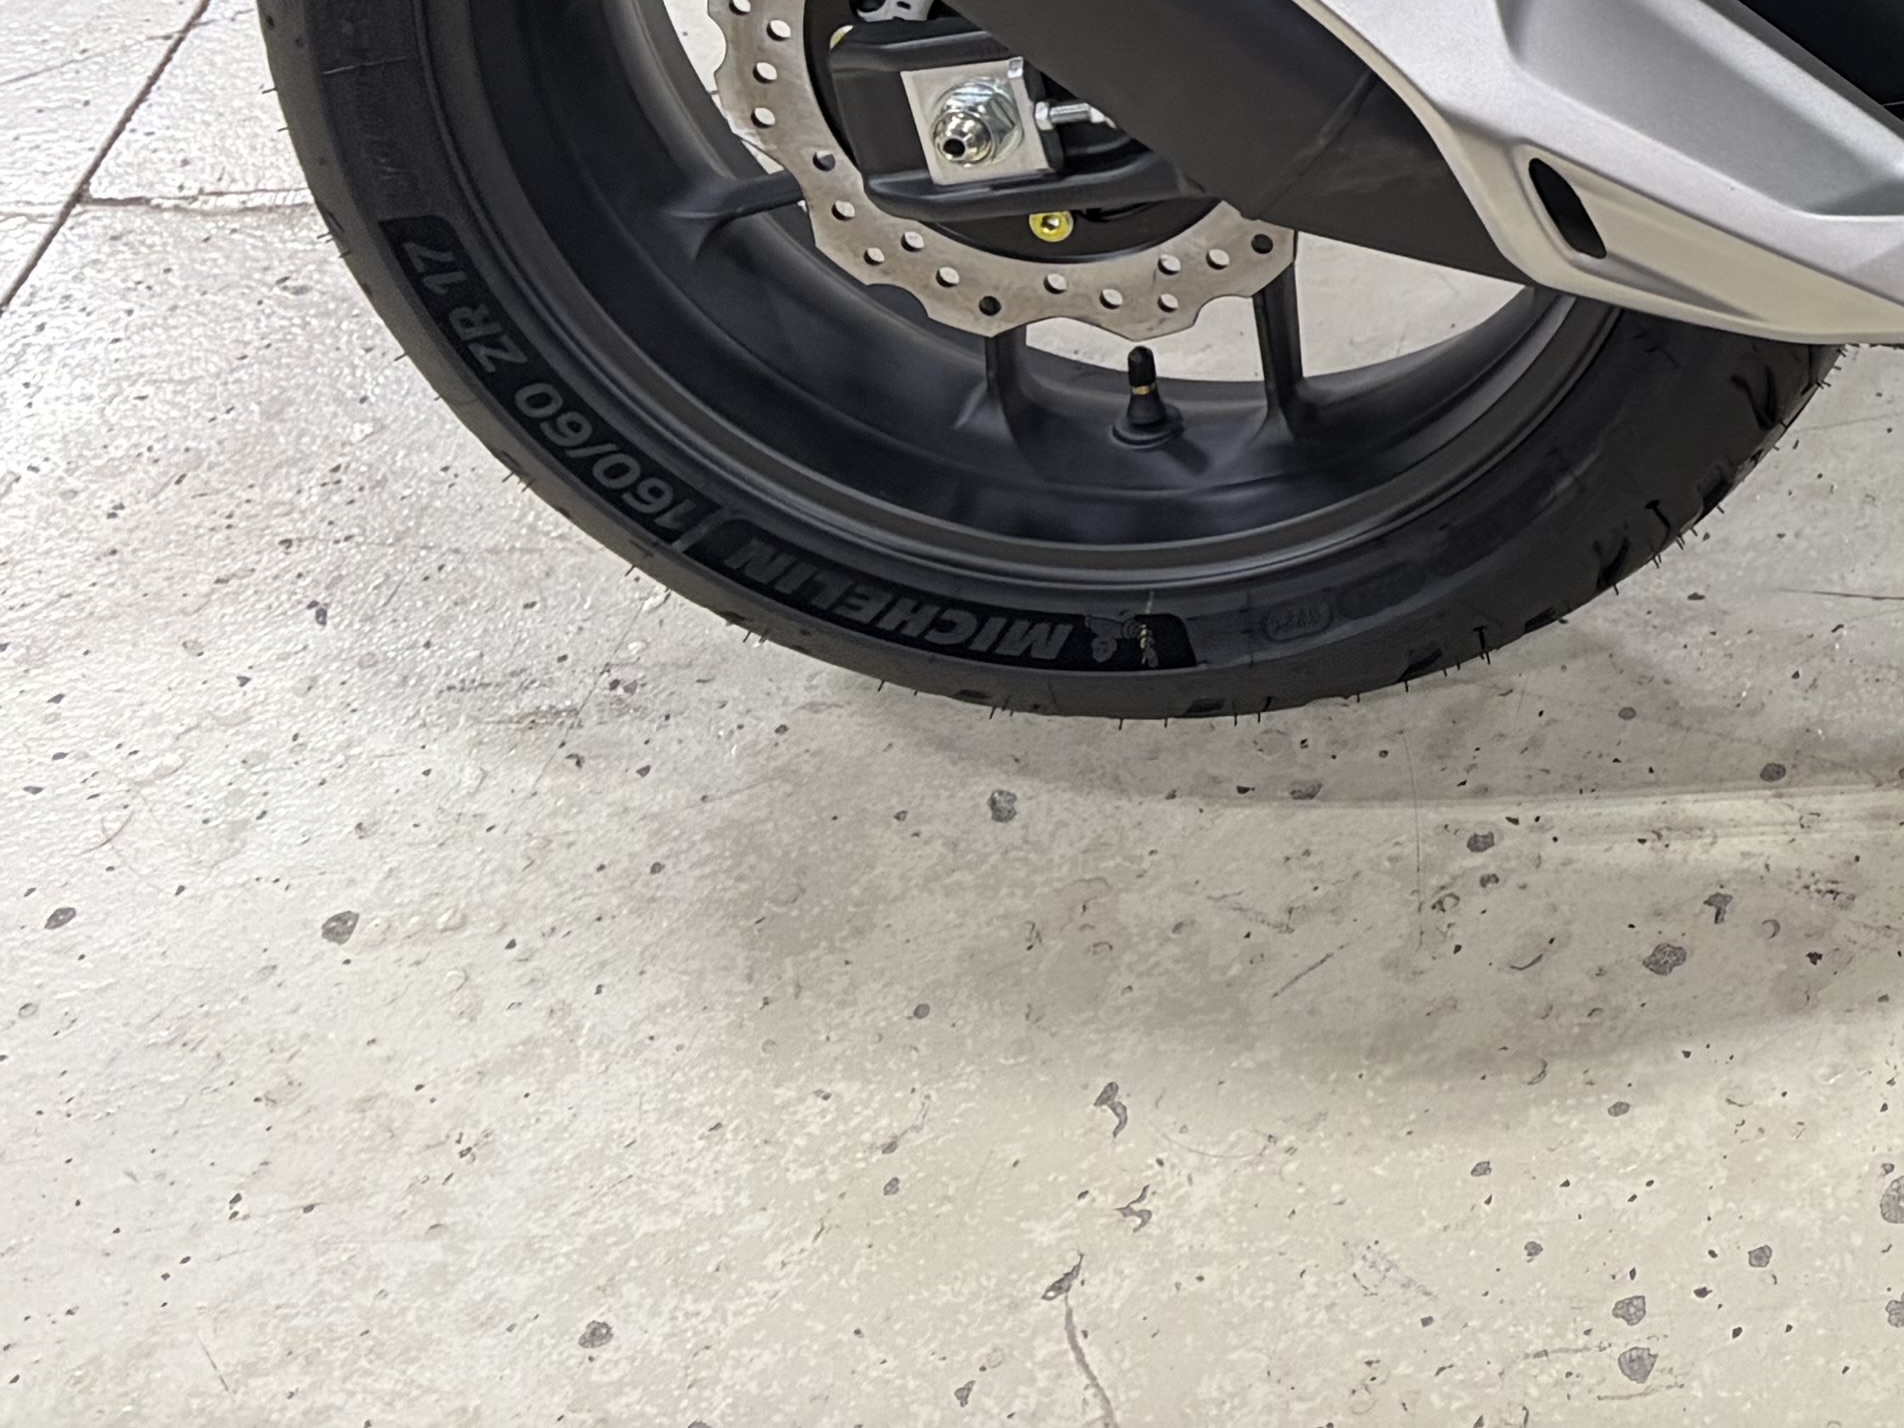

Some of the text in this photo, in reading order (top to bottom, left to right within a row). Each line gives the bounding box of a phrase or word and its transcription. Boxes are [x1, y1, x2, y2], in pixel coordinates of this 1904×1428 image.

[404, 242, 1072, 659] MICHELIN 160/60 ZR 17
